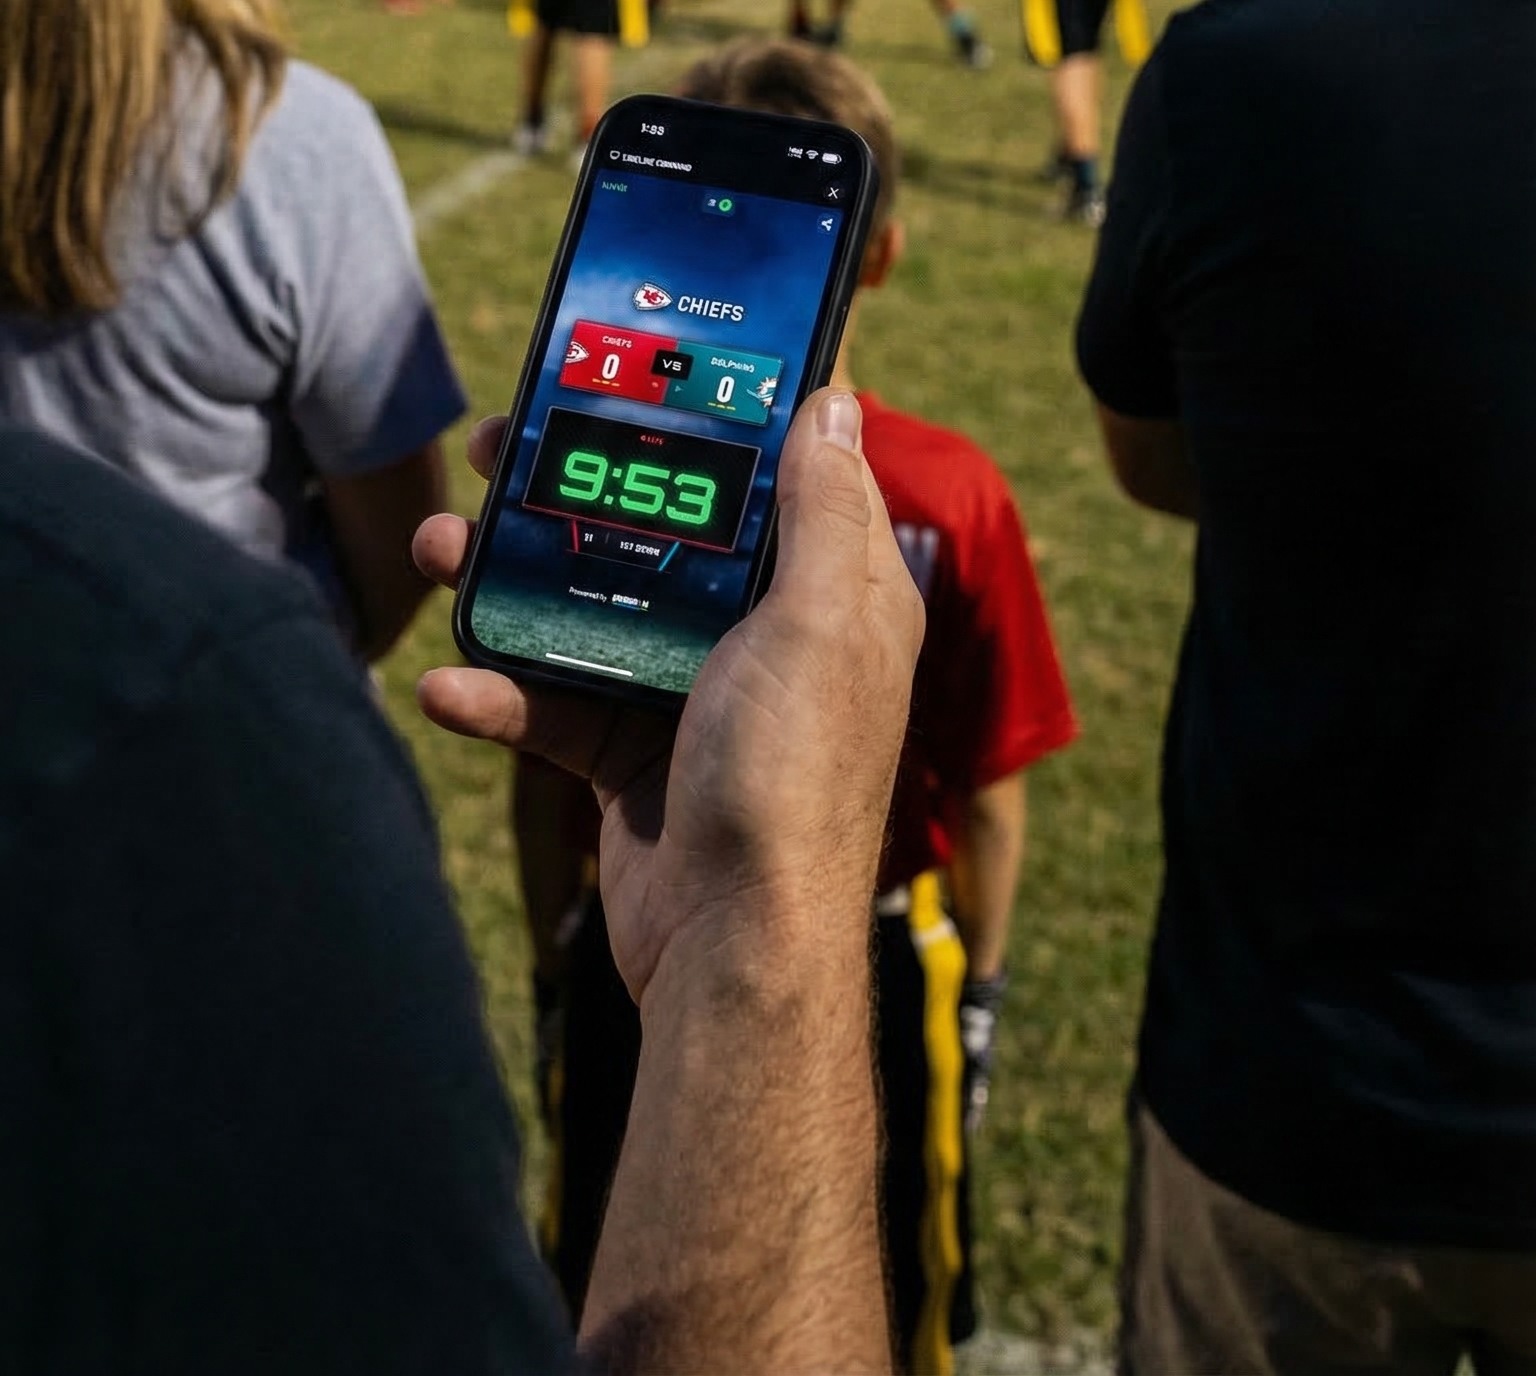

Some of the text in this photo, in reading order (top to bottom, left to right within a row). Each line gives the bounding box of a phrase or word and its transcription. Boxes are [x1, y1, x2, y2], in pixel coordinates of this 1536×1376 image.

[677, 295, 744, 322] CHIEFS
[601, 353, 620, 380] 0
[662, 358, 683, 372] VS
[716, 375, 735, 404] 0
[559, 450, 717, 525] 9:53
